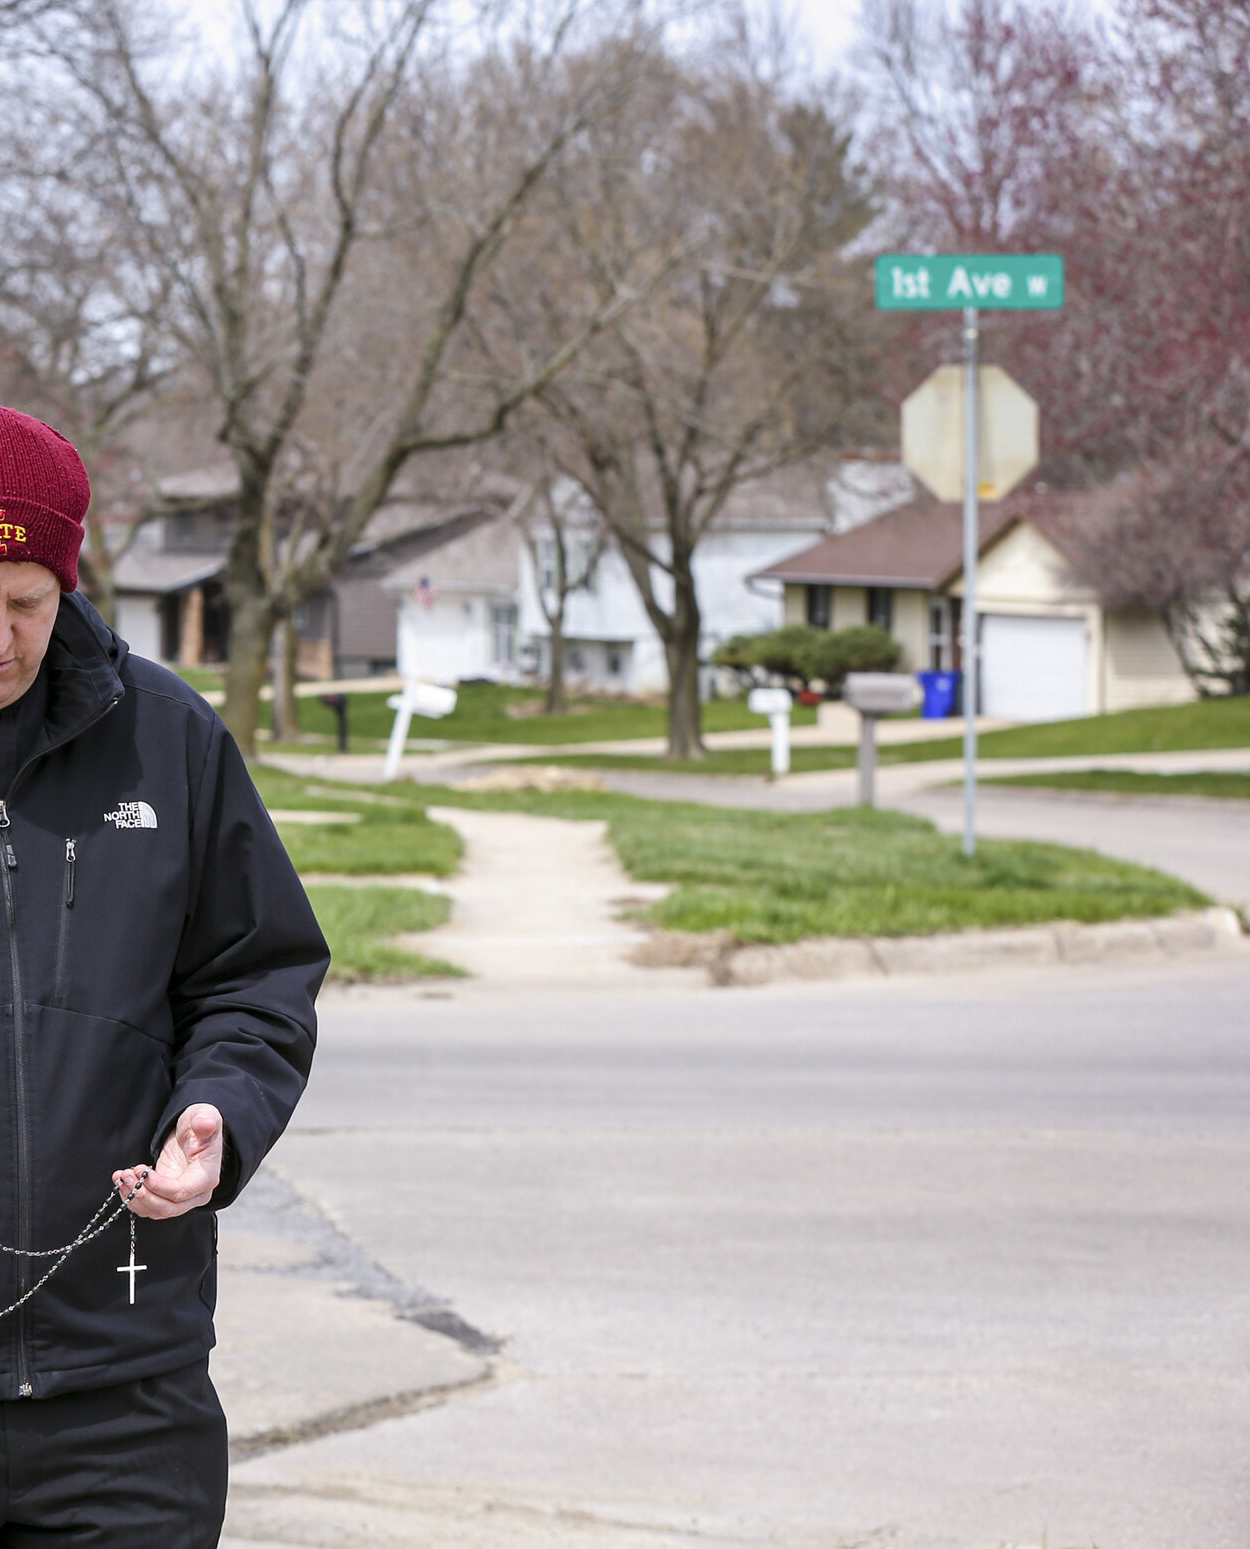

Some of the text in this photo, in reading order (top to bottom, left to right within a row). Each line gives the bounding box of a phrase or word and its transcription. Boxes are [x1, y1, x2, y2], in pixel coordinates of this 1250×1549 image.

[892, 265, 931, 298] 1st
[946, 265, 1013, 298] Ave
[118, 802, 139, 811] THE
[103, 810, 140, 822] NORTH
[115, 819, 142, 829] FACE
